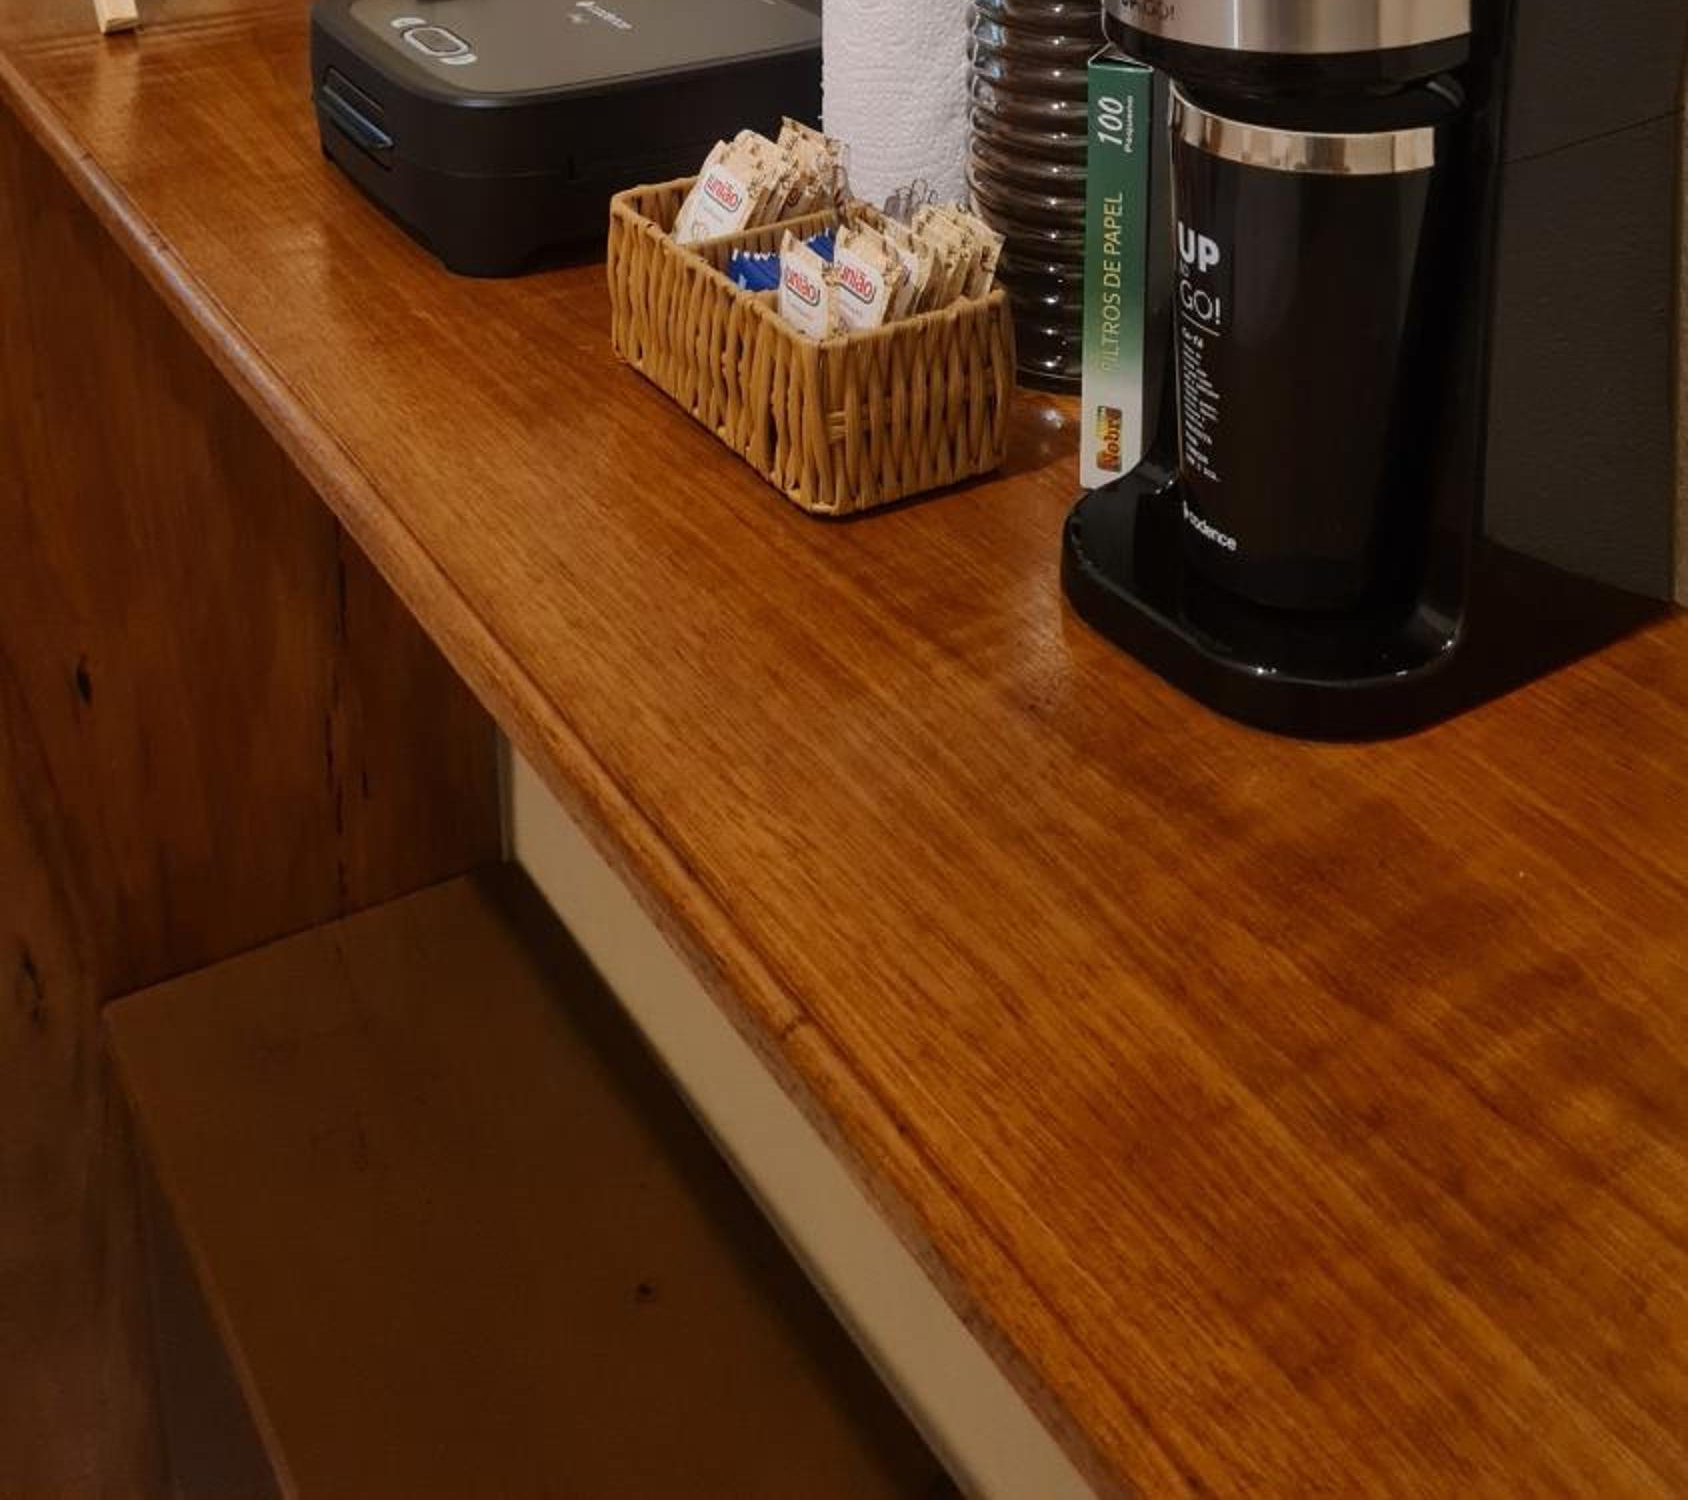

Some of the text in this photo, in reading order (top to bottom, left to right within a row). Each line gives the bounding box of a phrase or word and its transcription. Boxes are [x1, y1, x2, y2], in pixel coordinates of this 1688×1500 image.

[1097, 96, 1123, 145] 100
[1178, 220, 1220, 273] UP
[1101, 191, 1122, 373] FILTROS DE PAPEL
[1180, 279, 1221, 325] GO!
